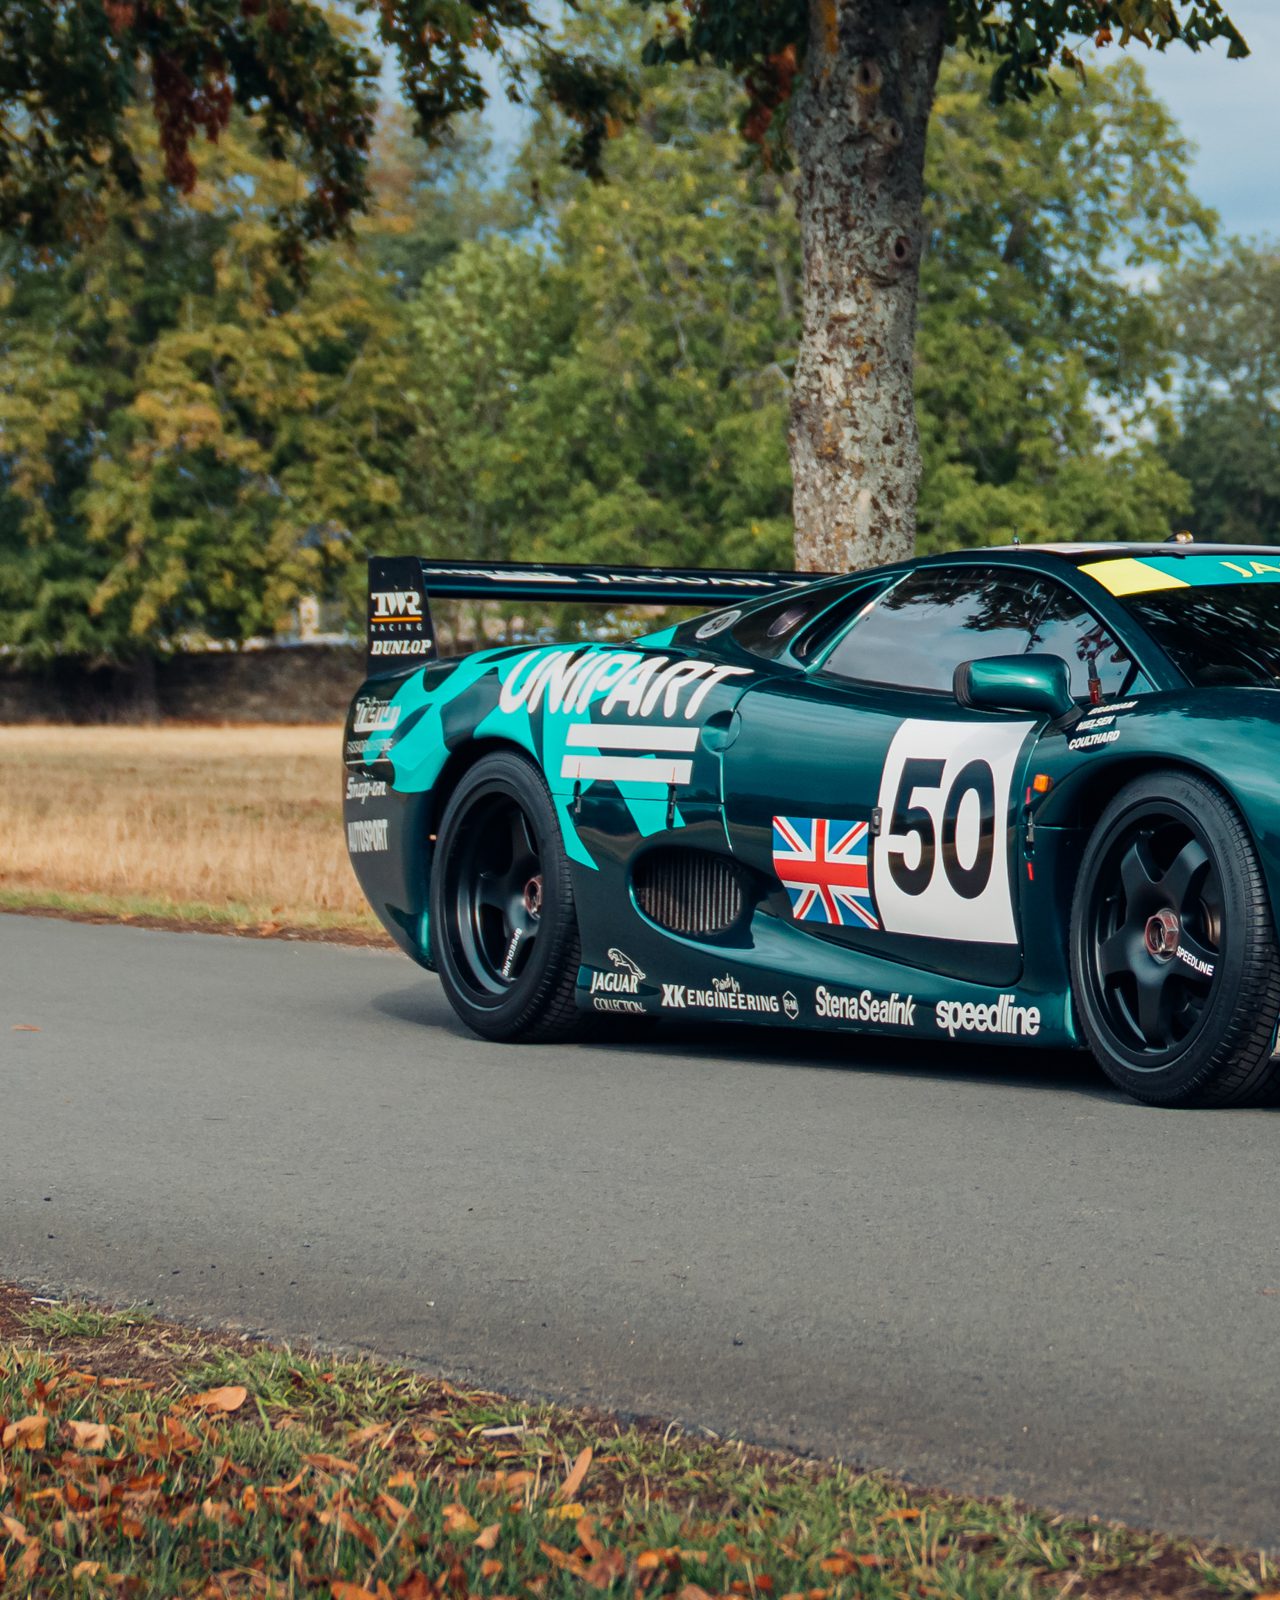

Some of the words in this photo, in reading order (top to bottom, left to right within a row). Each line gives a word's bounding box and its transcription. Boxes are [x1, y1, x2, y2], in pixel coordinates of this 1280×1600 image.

[370, 591, 423, 617] TWR
[370, 623, 423, 632] RACING
[370, 639, 432, 656] DUNLOP
[498, 649, 755, 720] UNIPART
[1075, 715, 1116, 732] NIELSEN
[1068, 729, 1121, 751] COULTHARD
[345, 776, 387, 805] Snap-on
[347, 818, 388, 853] AUTOSPORT
[887, 757, 996, 900] 50
[1175, 945, 1215, 977] SPEEDLINE
[589, 971, 640, 995] JAGUAR
[593, 996, 647, 1014] COLLECTION
[660, 983, 687, 1008] XK
[687, 990, 781, 1013] ENGINEERING
[935, 993, 1041, 1037] speedline
